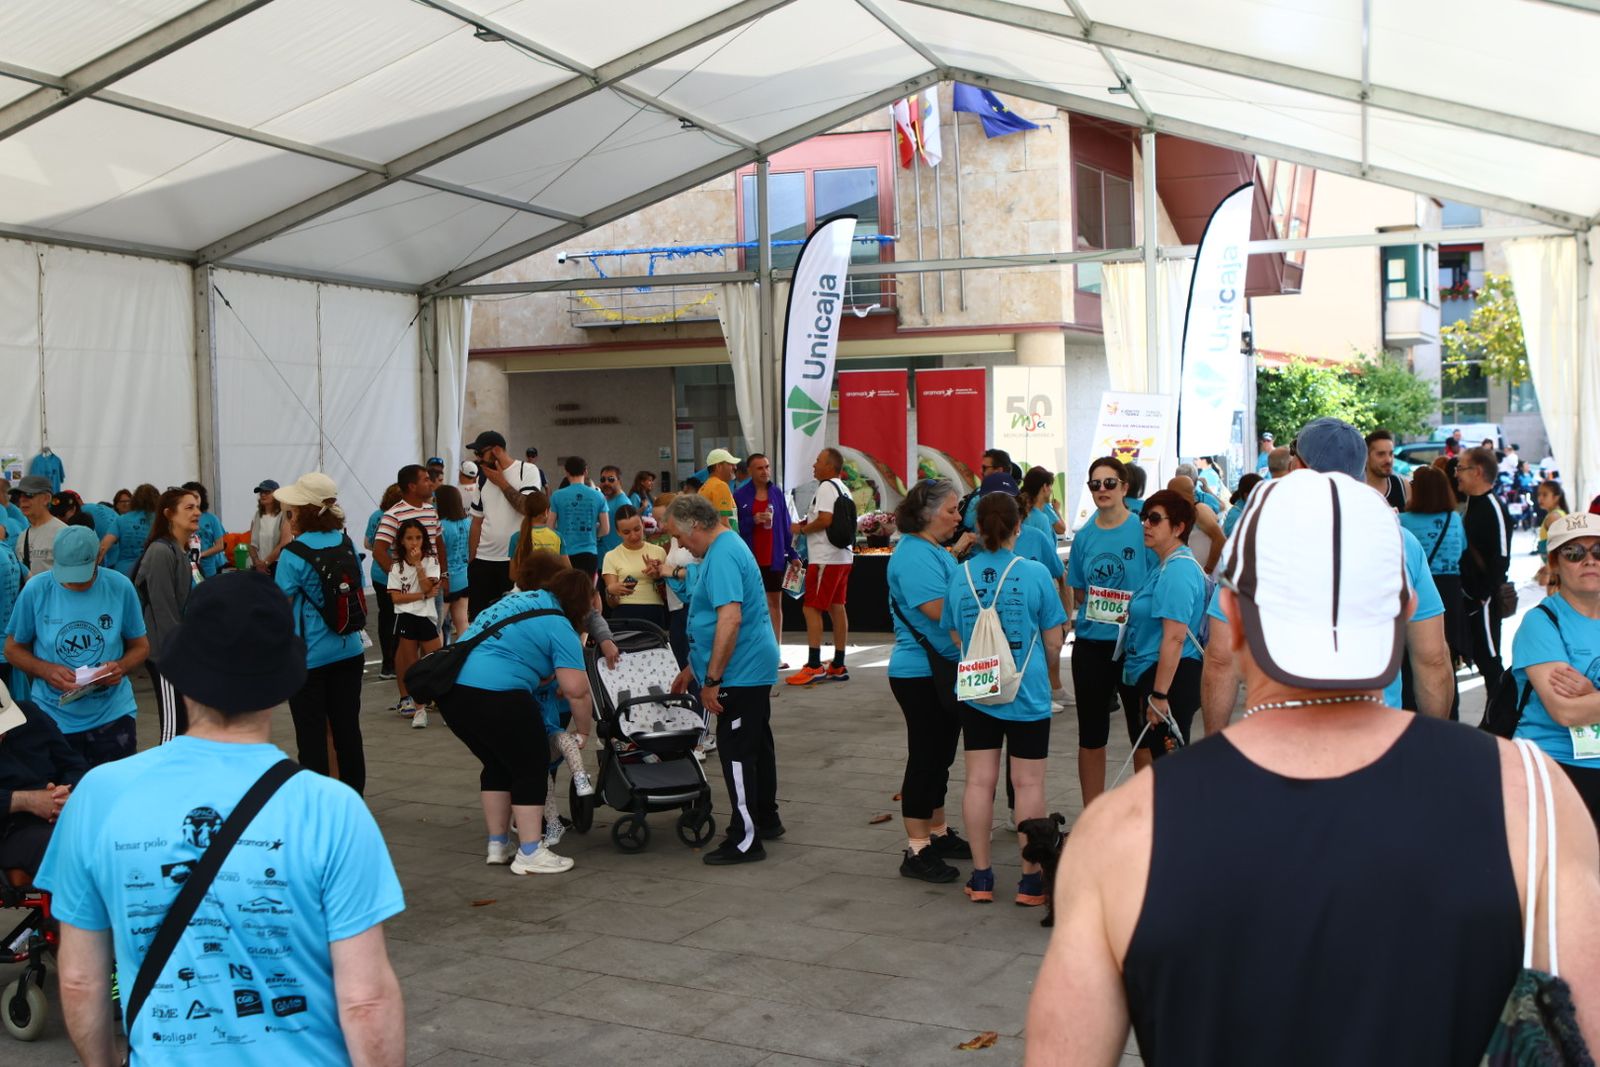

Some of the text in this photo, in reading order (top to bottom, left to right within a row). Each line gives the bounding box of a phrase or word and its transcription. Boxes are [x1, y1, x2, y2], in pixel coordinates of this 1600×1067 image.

[1208, 245, 1243, 352] Unicaja
[802, 273, 841, 381] Unicaja
[1089, 586, 1131, 601] bedunia
[1094, 599, 1123, 614] 1006
[959, 658, 999, 673] bedunia
[966, 671, 994, 687] 1206
[115, 837, 168, 852] henar polo
[161, 1031, 198, 1045] poligar
